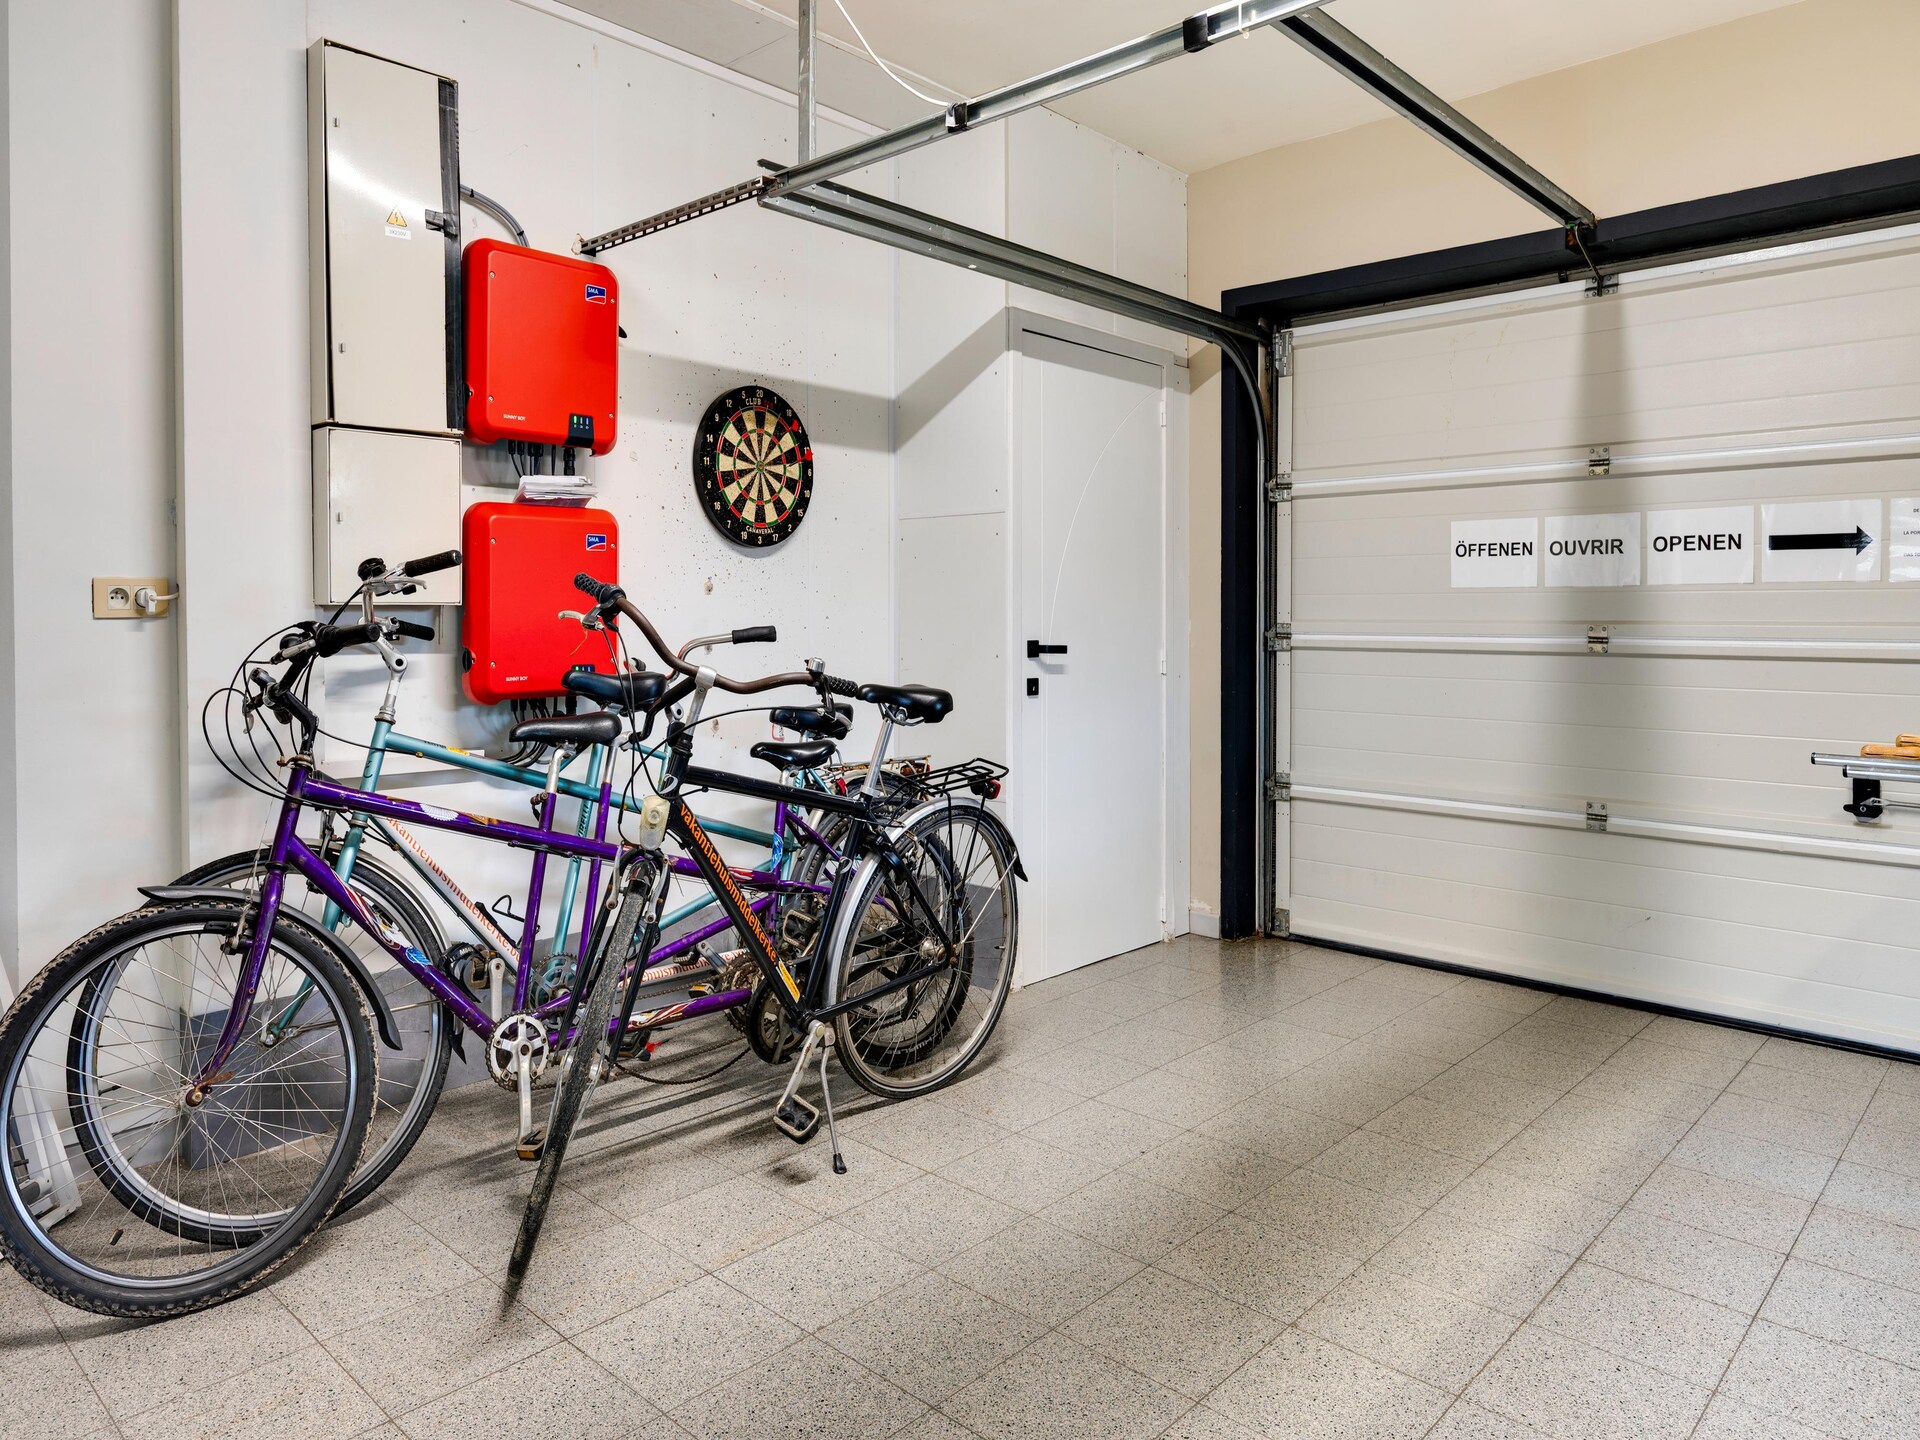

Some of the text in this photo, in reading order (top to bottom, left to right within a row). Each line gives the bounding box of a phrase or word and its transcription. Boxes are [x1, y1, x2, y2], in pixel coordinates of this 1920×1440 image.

[742, 390, 746, 398] 5
[756, 390, 764, 398] 20
[726, 399, 732, 407] 12
[786, 409, 792, 417] 18
[706, 434, 713, 442] 14
[703, 457, 710, 465] 11
[707, 480, 711, 488] 8
[714, 502, 720, 510] 16
[741, 532, 747, 540] 19
[758, 536, 762, 544] 3
[1652, 533, 1743, 553] OPENEN
[1455, 540, 1534, 559] ÖFFENEN
[1549, 538, 1624, 557] OUVRIR
